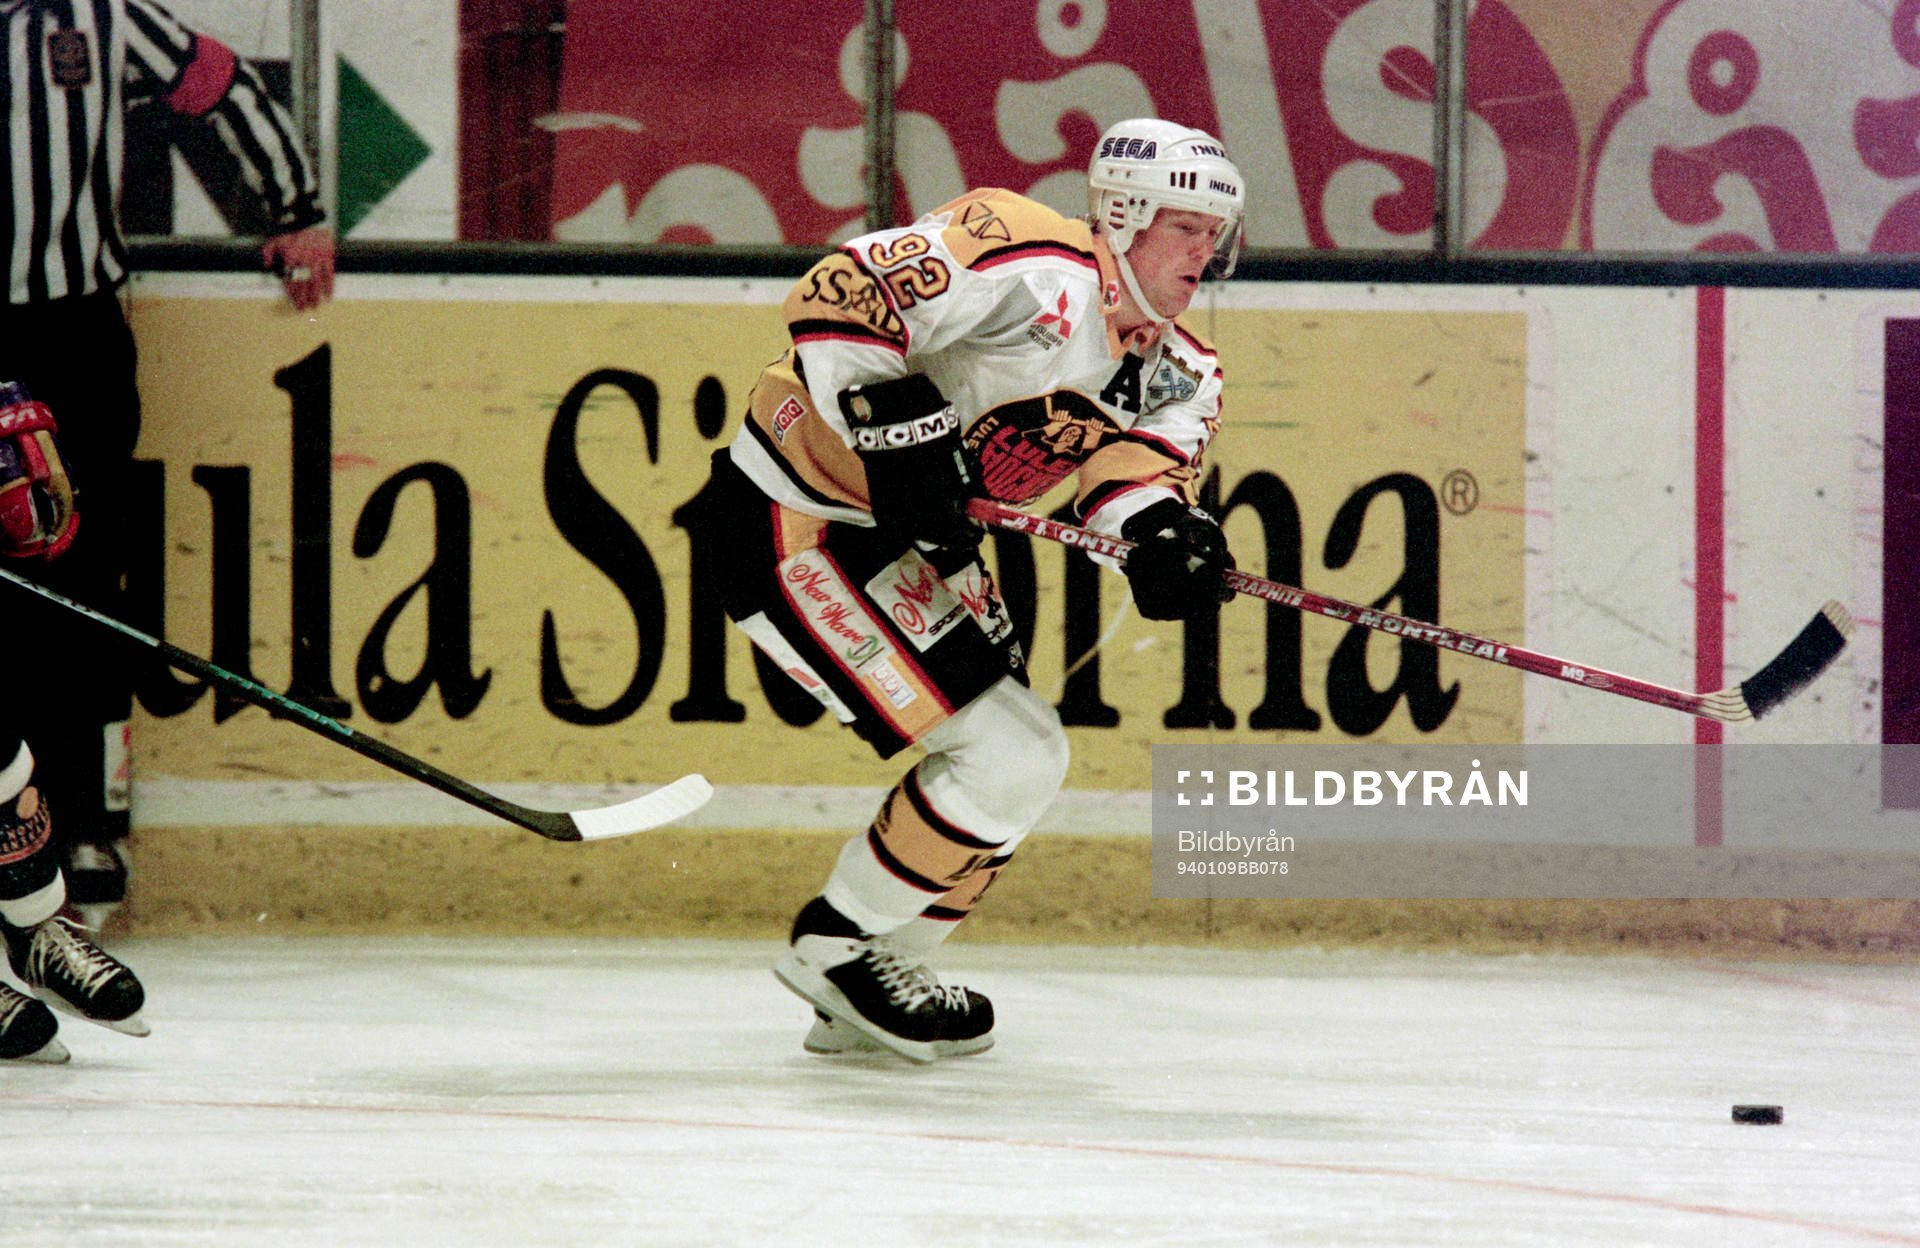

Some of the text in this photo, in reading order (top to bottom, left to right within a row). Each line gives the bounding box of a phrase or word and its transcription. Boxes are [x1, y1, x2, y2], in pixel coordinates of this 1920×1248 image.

[1100, 137, 1157, 160] SEGA
[1209, 179, 1237, 197] INEXA
[868, 233, 951, 311] 92
[1100, 351, 1144, 414] A
[968, 416, 999, 449] LULE
[130, 342, 491, 726] ula
[787, 564, 865, 644] New Wave
[1358, 611, 1510, 664] MONTREAL
[1561, 665, 1585, 682] M9
